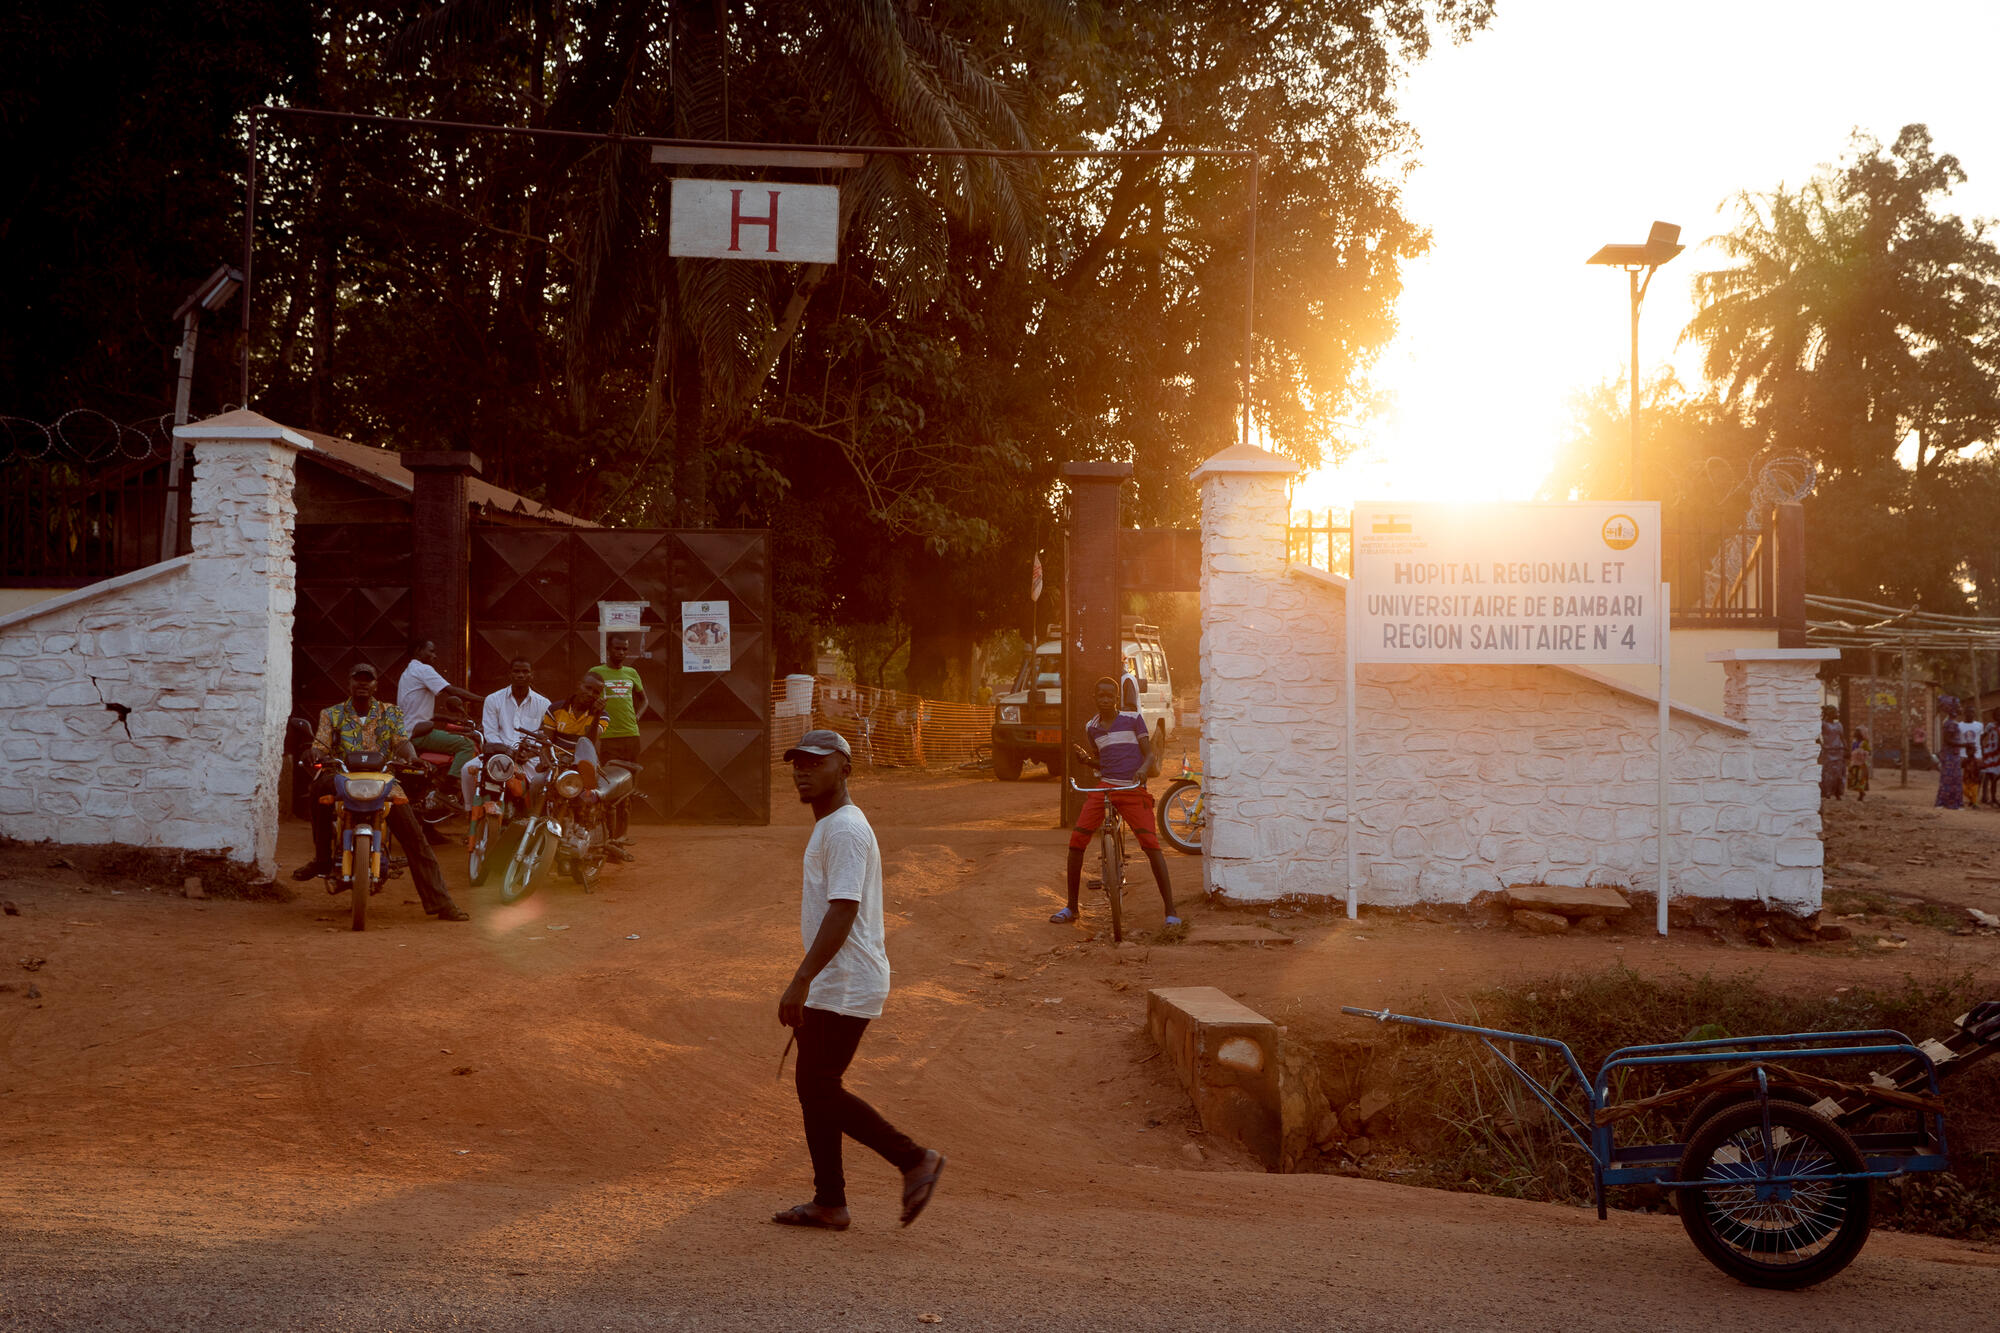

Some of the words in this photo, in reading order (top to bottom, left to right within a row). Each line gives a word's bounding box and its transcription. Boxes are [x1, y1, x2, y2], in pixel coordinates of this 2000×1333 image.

[728, 190, 781, 252] H
[1394, 563, 1485, 584] HOPITAL
[1492, 562, 1595, 583] REGIONAL
[1602, 561, 1624, 583] ET
[1368, 594, 1517, 616] UNIVERSITAIRE
[1524, 595, 1546, 616] DE
[1553, 595, 1643, 616] BAMBARI
[1383, 623, 1462, 649] REGION
[1470, 625, 1586, 650] SANITAIRE
